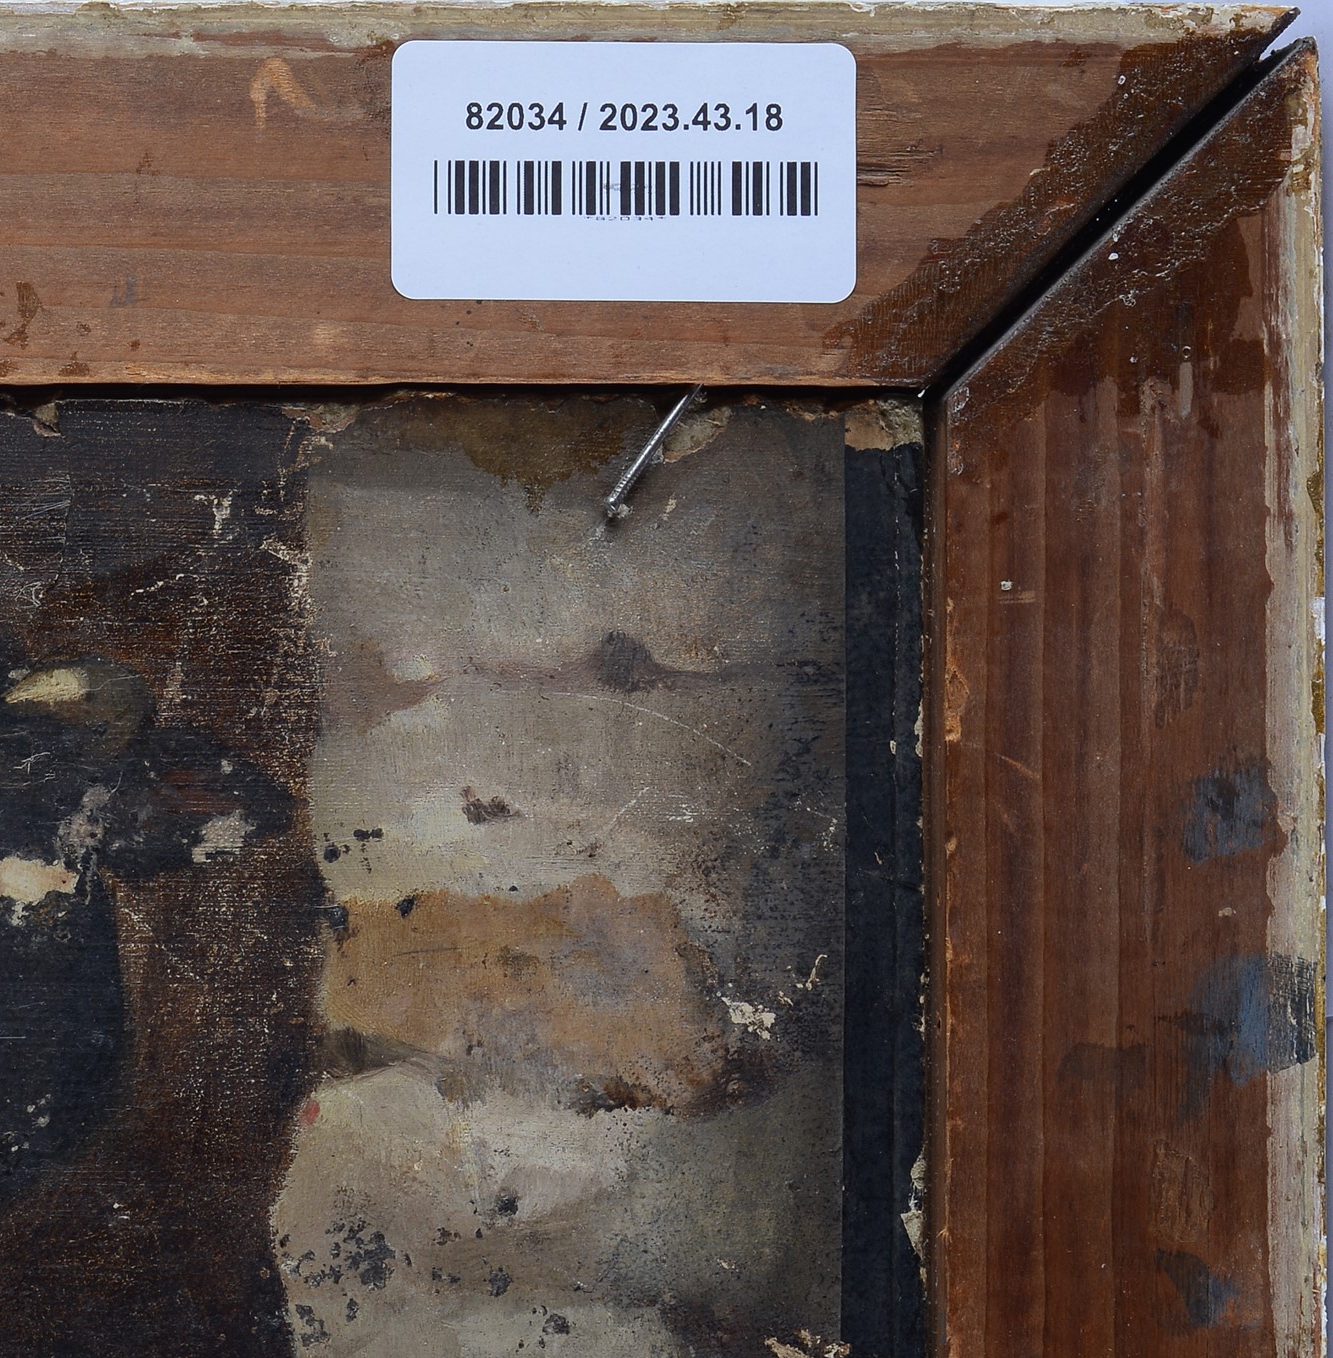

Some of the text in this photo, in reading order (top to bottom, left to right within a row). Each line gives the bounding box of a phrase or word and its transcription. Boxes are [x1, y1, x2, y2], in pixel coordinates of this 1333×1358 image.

[466, 102, 782, 131] 82034 / 2023.43.18
